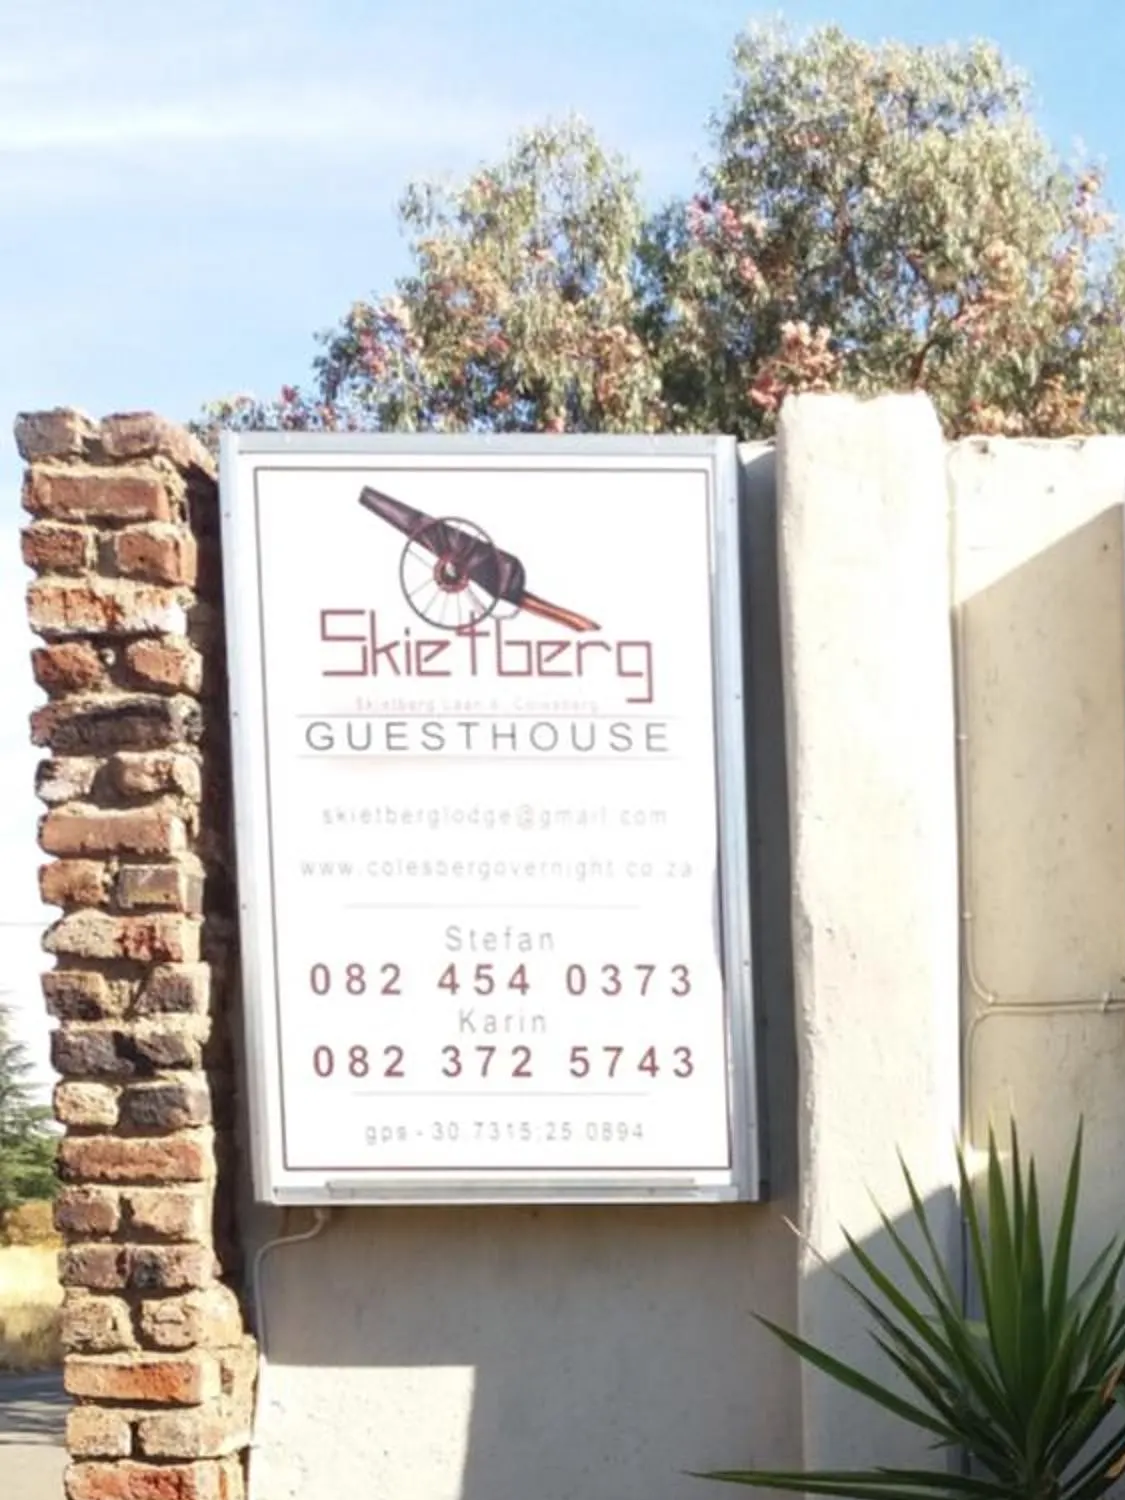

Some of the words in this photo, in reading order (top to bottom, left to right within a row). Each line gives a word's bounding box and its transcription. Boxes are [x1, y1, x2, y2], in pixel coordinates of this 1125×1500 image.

[320, 609, 655, 704] Skietberg
[304, 721, 669, 753] GUESTHOUSE
[444, 924, 555, 953] Stefan
[309, 963, 402, 996] 082
[437, 963, 531, 996] 454
[565, 963, 692, 997] 0373
[458, 1008, 547, 1035] Karin
[312, 1045, 405, 1079] 082
[441, 1045, 533, 1079] 372
[569, 1045, 695, 1079] 5743
